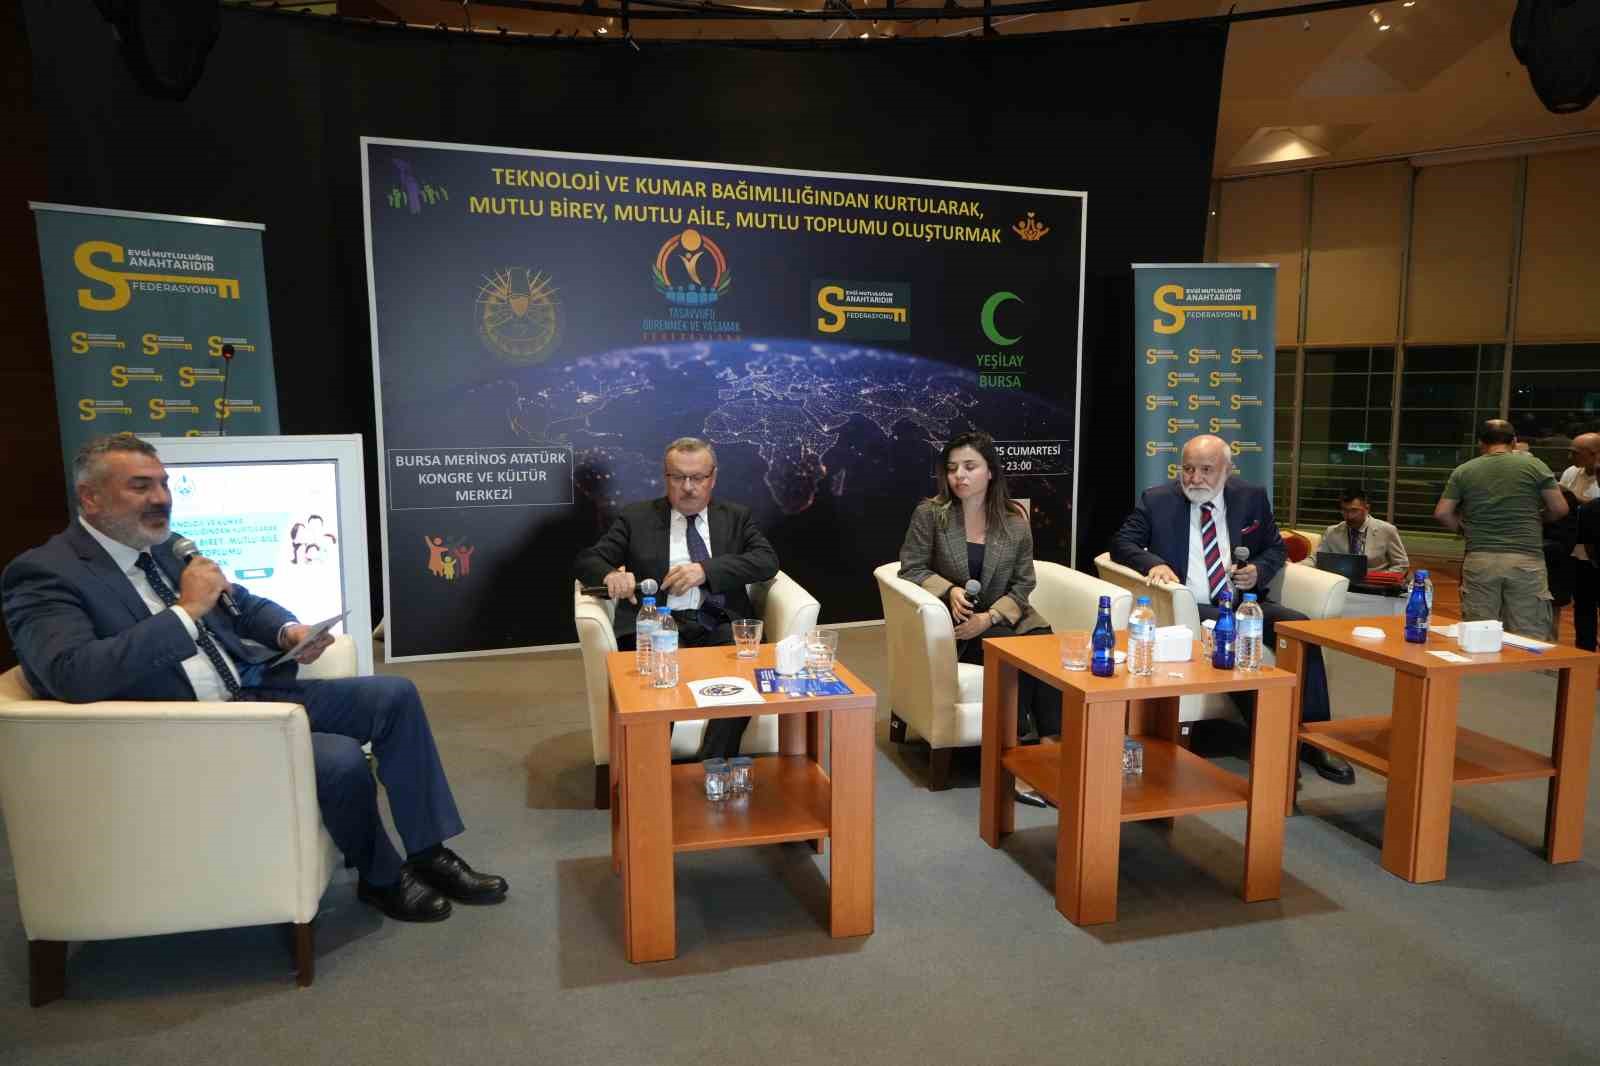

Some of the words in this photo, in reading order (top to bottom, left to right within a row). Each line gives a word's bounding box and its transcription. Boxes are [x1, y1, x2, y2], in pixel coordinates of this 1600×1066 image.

[491, 168, 600, 191] TEKNOLOJİ
[605, 175, 629, 193] VE
[635, 177, 707, 198] KUMAR
[712, 180, 869, 209] BAĞIMLILIĞINDAN
[874, 194, 984, 220] KURTULARAK,
[469, 196, 544, 216] MUTLU
[550, 198, 608, 223] BİREY,
[614, 204, 682, 224] MUTLU
[687, 206, 731, 229] AİLE,
[736, 211, 800, 231] MUTLU
[804, 216, 888, 236] TOPLUMU
[892, 222, 1001, 243] OLUŞTURMAK
[129, 257, 215, 272] ANAHTARIDIR
[132, 281, 217, 295] FEDERASYONU
[976, 352, 1024, 369] YEŞİLAY
[979, 375, 1021, 388] BURSA
[1007, 444, 1061, 456] CUMARTESİ
[395, 455, 441, 467] BURSA
[445, 452, 506, 466] MERİNOS
[510, 451, 567, 465] ATATÜRK
[1006, 461, 1032, 471] 23:00
[418, 471, 473, 485] KONGRE
[477, 471, 494, 483] VE
[497, 469, 547, 482] KÜLTÜR
[455, 487, 513, 501] MERKEZİ
